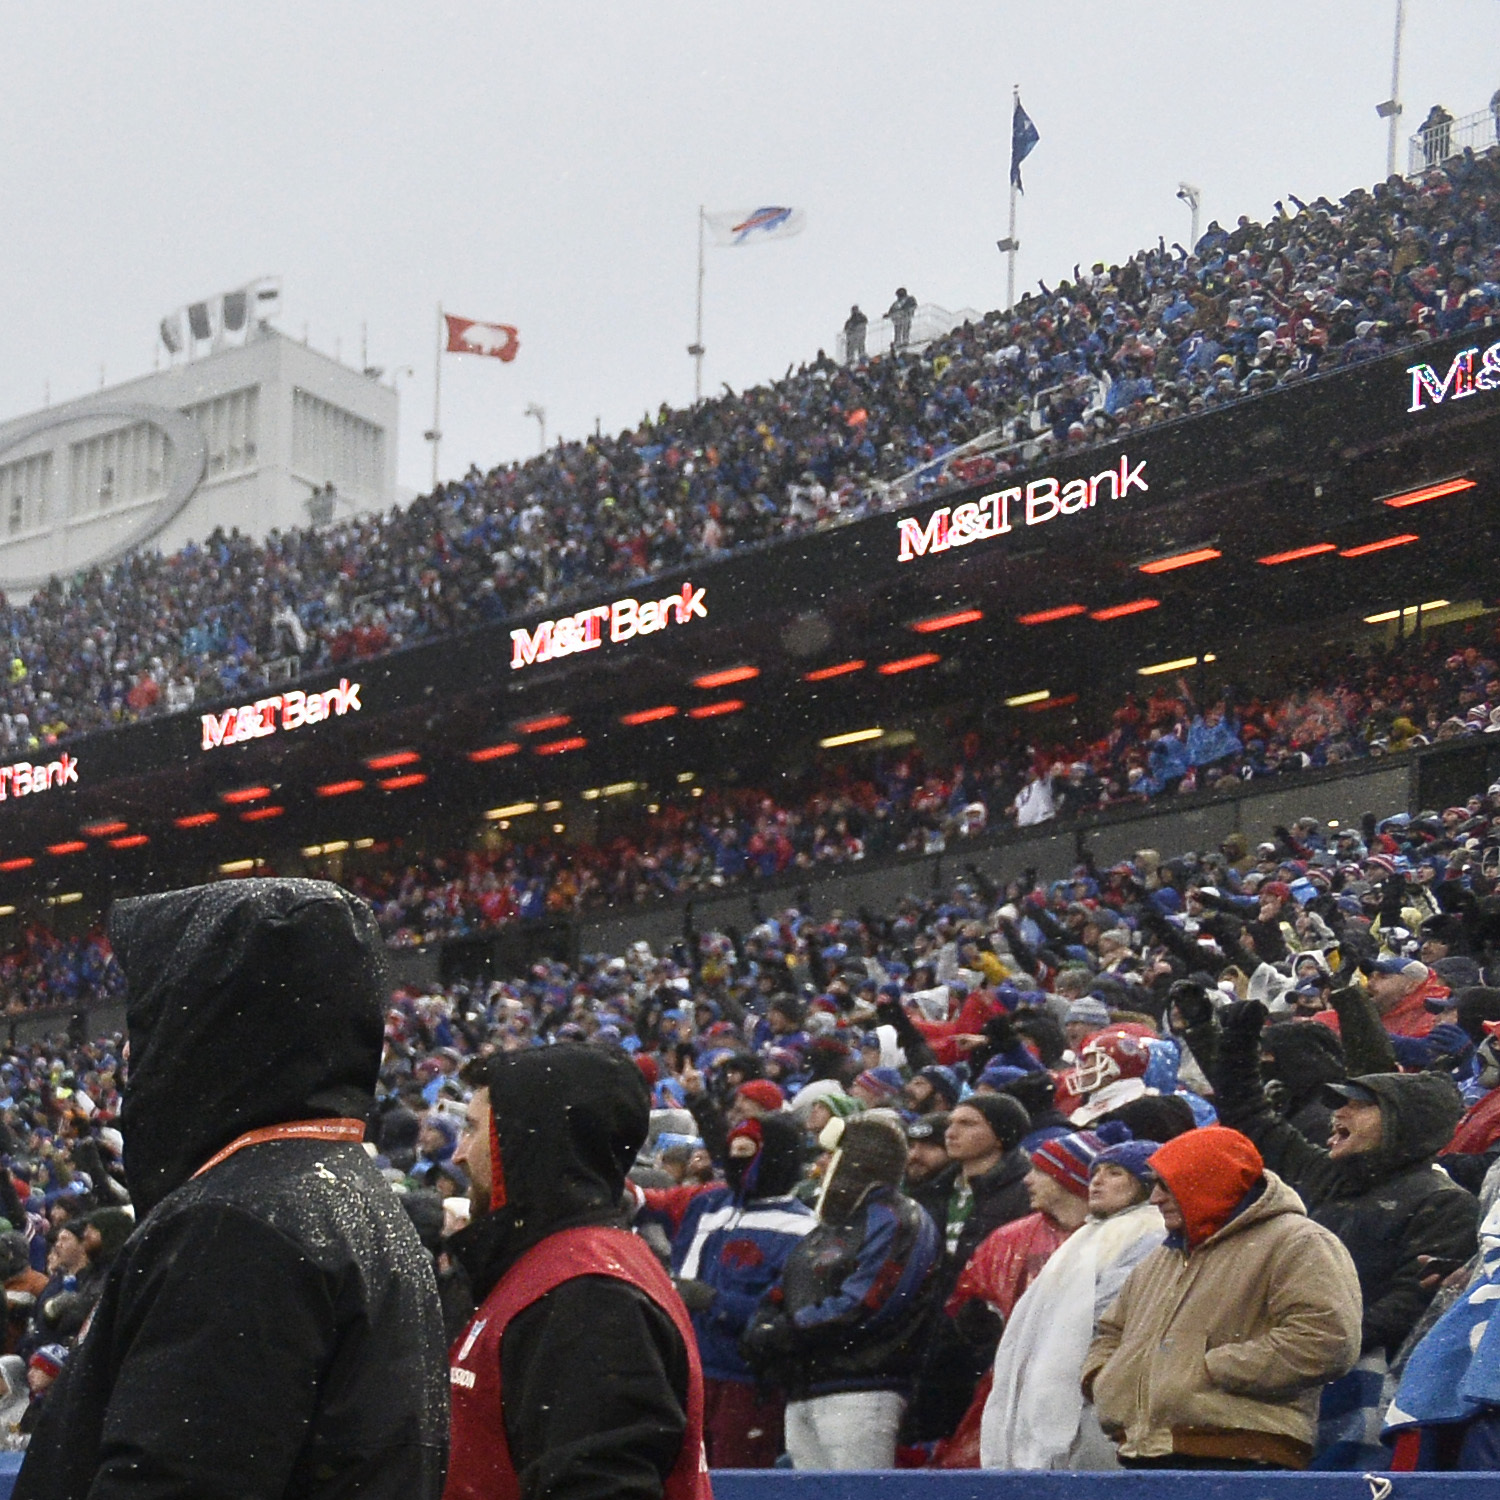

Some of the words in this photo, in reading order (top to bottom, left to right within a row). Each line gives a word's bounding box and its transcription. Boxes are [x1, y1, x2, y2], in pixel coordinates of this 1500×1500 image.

[897, 486, 1022, 561] M&T
[510, 607, 608, 668] M&T
[202, 699, 281, 749] M&T
